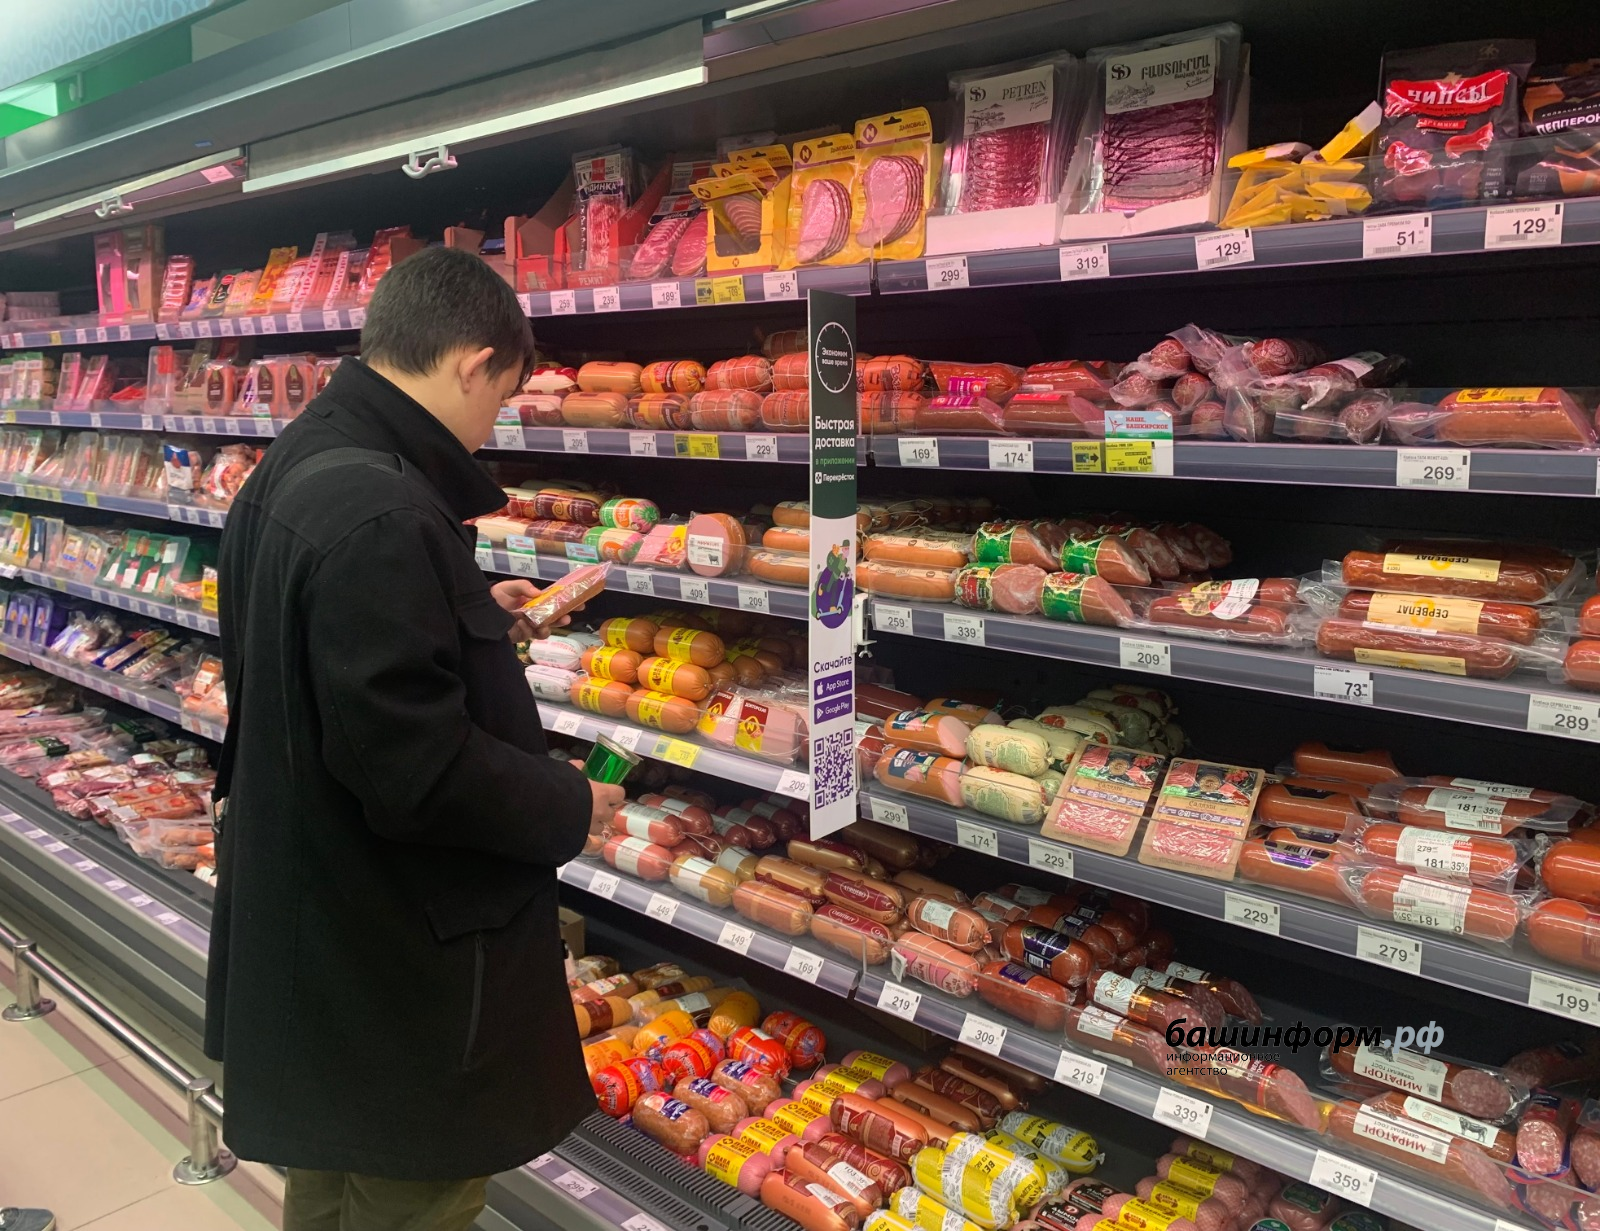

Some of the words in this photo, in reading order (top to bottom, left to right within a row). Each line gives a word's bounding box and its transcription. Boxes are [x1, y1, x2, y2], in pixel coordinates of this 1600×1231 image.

[1002, 80, 1047, 100] PETREN
[1407, 84, 1489, 105] ЧИПСЫ
[1512, 218, 1546, 235] 129
[1396, 230, 1416, 246] 51
[1215, 241, 1241, 258] 129
[1076, 256, 1099, 271] 319
[940, 269, 960, 282] 299
[779, 282, 792, 293] 95
[602, 296, 615, 305] 239
[661, 292, 675, 302] 189
[821, 346, 848, 358] Экономим
[821, 358, 834, 366] ваше
[834, 358, 848, 367] время
[815, 415, 855, 431] Быстрая
[642, 442, 651, 452] 77
[815, 435, 855, 449] доставка
[756, 446, 771, 455] 229
[912, 448, 931, 460] 169
[819, 457, 856, 467] приложении
[1004, 452, 1025, 464] 174
[1138, 457, 1147, 466] 40
[823, 472, 855, 483] Перекрёсток
[1423, 466, 1455, 480] 269
[689, 588, 703, 599] 409
[748, 596, 763, 607] 209
[1396, 604, 1449, 619] СЕРВЕЛАТ
[887, 616, 905, 628] 259
[957, 626, 976, 639] 339
[813, 655, 853, 674] Скачайте
[1137, 651, 1160, 666] 209
[826, 681, 835, 692] App
[836, 678, 850, 690] Store
[1344, 681, 1362, 698] 73
[744, 702, 767, 713] ДОКТОРСКАЯ
[825, 703, 840, 716] Google
[840, 700, 850, 712] Play
[1554, 713, 1589, 731] 289
[789, 780, 806, 791] 209
[884, 809, 901, 823] 299
[1457, 803, 1477, 813] 181
[1483, 806, 1501, 815] 35%
[971, 834, 990, 849] 174
[1417, 845, 1432, 853] 279
[1044, 853, 1064, 867] 229
[1424, 858, 1444, 869] 181
[1451, 861, 1469, 871] 35%
[597, 881, 611, 893] 419
[656, 904, 670, 917] 449
[1243, 909, 1269, 924] 229
[1419, 915, 1440, 927] 181
[731, 934, 745, 946] 149
[1379, 944, 1408, 962] 279
[798, 961, 813, 975] 169
[891, 997, 910, 1011] 219
[1555, 993, 1589, 1012] 199
[975, 1030, 995, 1045] 309
[1371, 1061, 1386, 1071] ГОСТ
[1072, 1068, 1094, 1084] 219
[1362, 1065, 1423, 1093] МИРАТОРГ
[1387, 1067, 1414, 1081] СЕРВЕЛАТ
[1173, 1104, 1198, 1122] 339
[1362, 1124, 1427, 1153] МИРАТОРГ
[844, 1166, 856, 1177] 103
[567, 1180, 585, 1194] 299
[1332, 1170, 1361, 1192] 359
